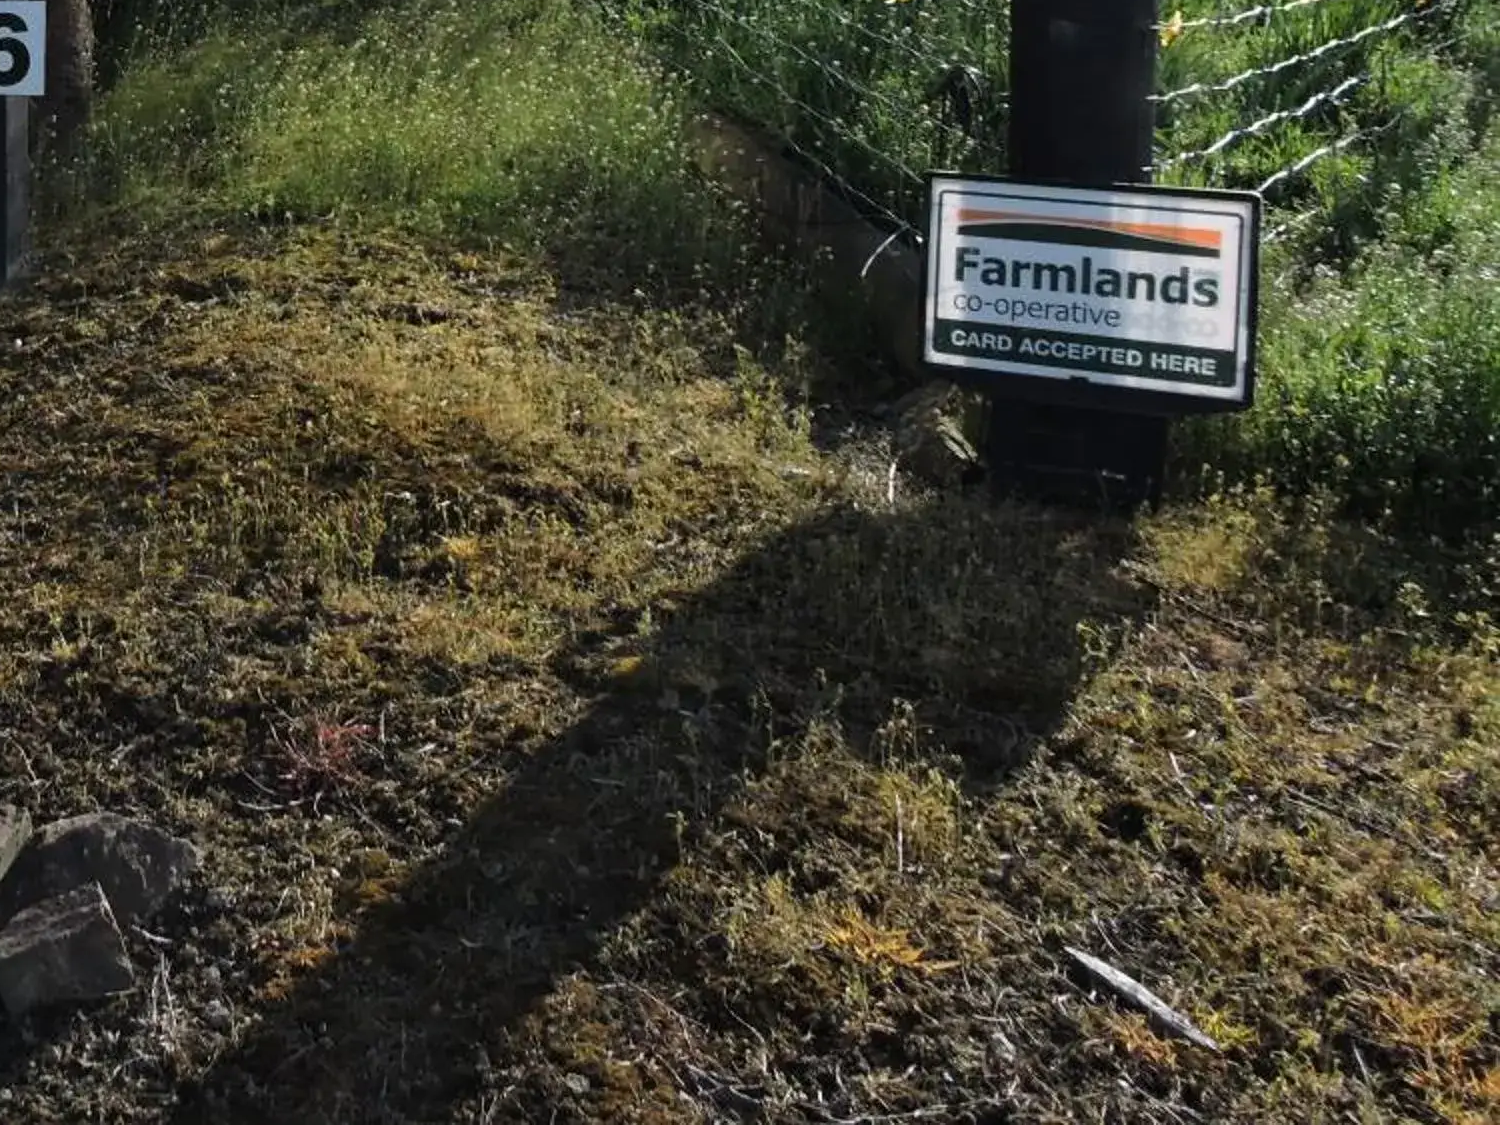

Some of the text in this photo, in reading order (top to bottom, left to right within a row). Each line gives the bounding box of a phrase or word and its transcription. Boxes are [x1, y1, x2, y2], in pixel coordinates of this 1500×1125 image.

[954, 246, 1220, 308] Farmlands
[952, 292, 1122, 328] co-operative
[950, 328, 1218, 377] CARD ACCEPTED HERE
